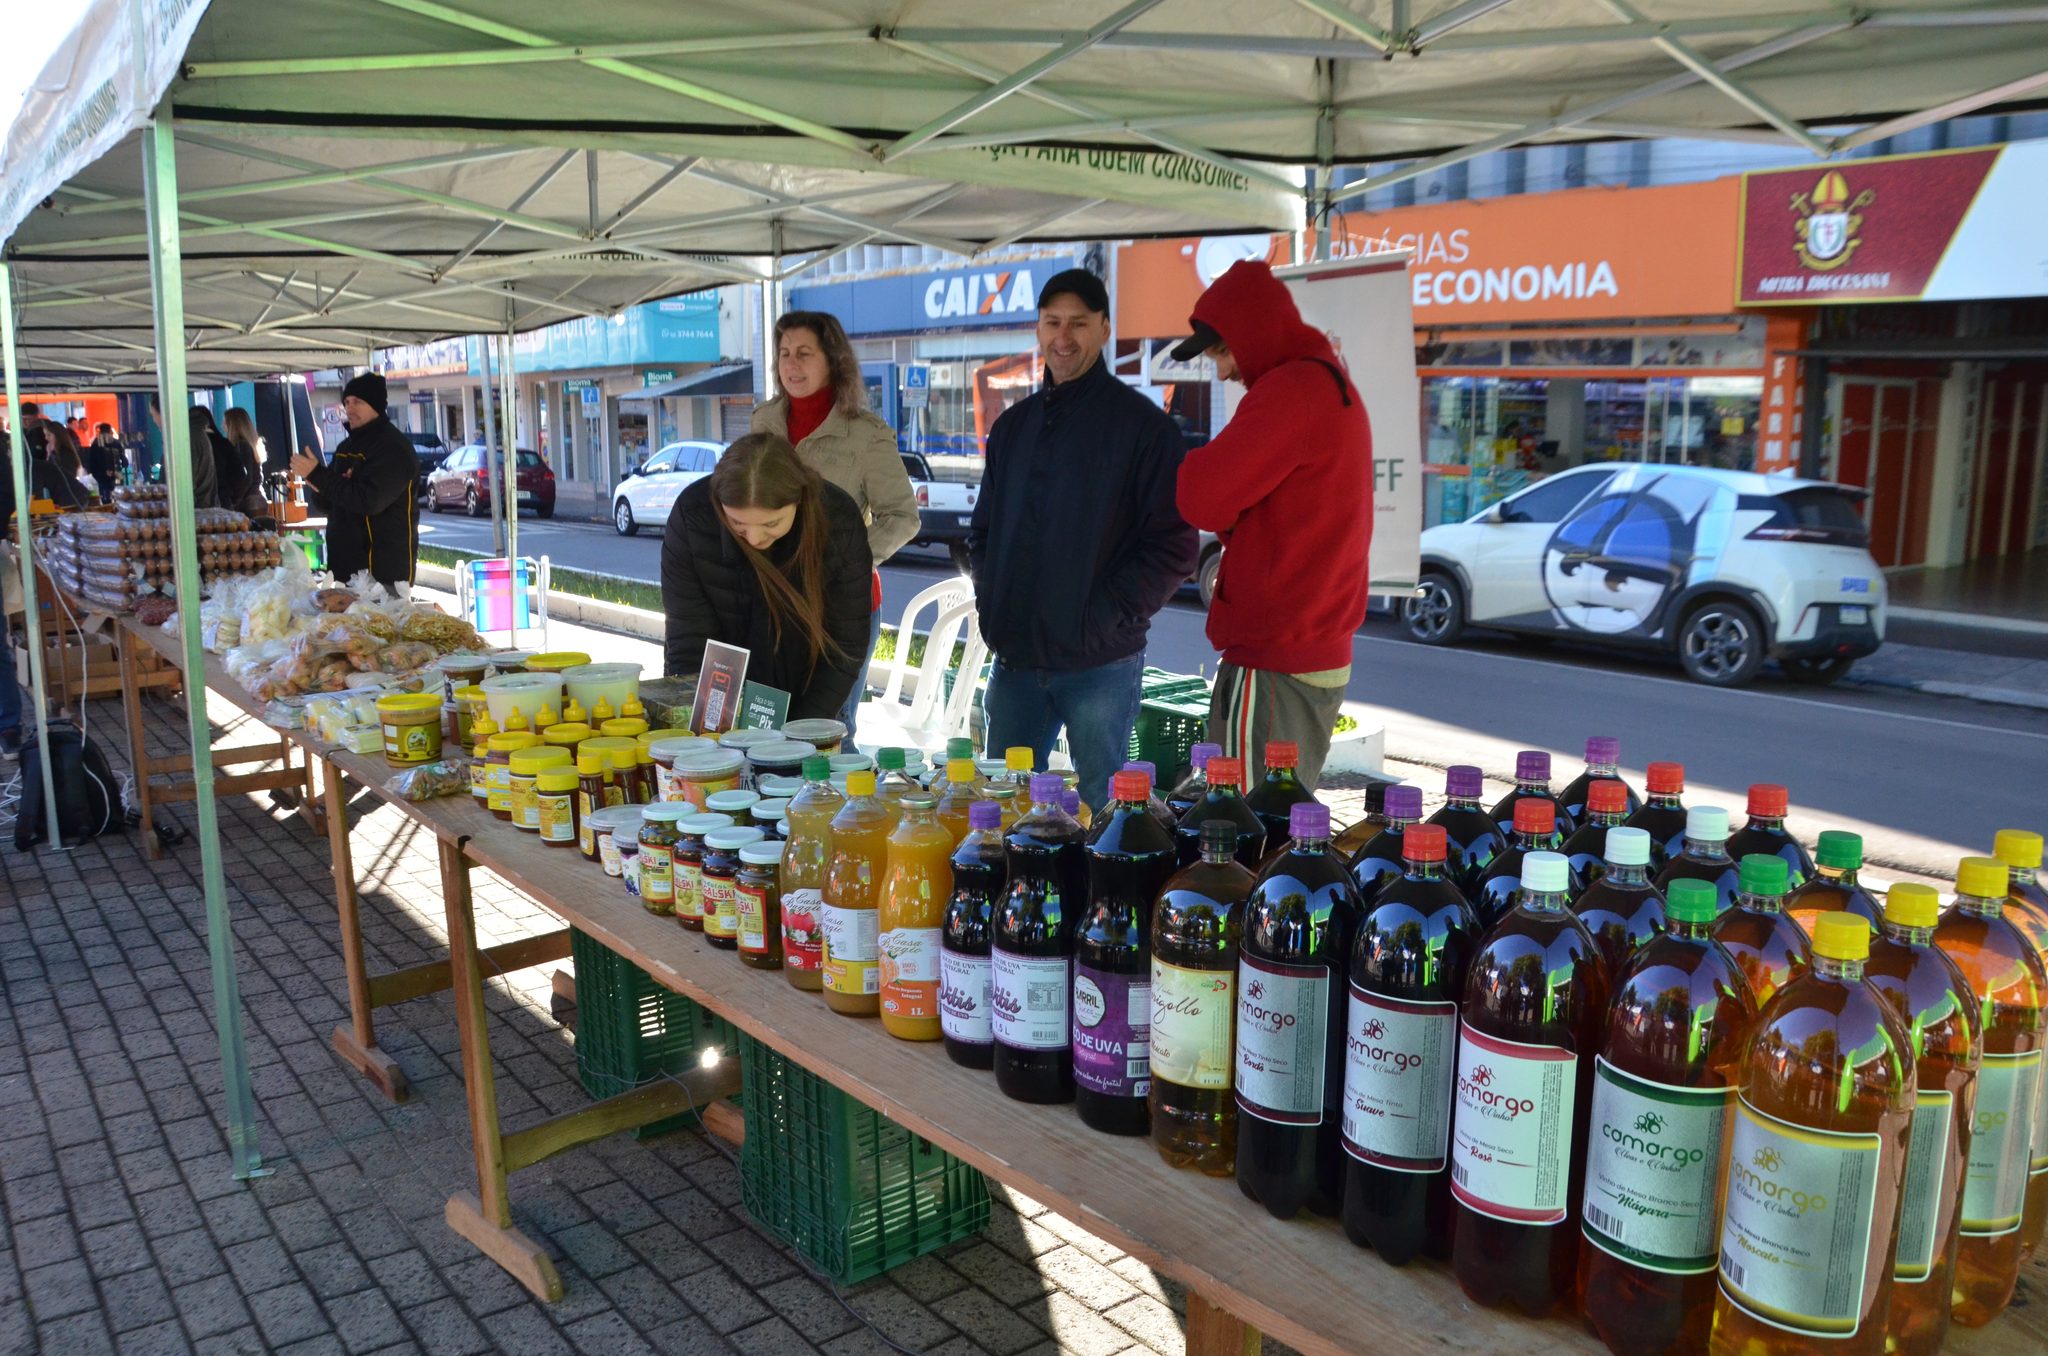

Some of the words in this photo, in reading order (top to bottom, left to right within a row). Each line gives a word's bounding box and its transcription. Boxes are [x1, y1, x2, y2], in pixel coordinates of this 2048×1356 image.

[1088, 148, 1144, 174] QUEM
[924, 269, 1035, 319] CAIXA
[1412, 260, 1618, 306] ECONOMIA
[1764, 356, 1787, 474] FARM
[750, 703, 775, 716] pagamento
[759, 715, 774, 730] Pix
[881, 939, 921, 955] Baggio
[893, 933, 923, 947] Casa
[962, 962, 977, 970] UVA
[940, 968, 977, 1012] Vitis
[911, 1007, 924, 1016] 1L
[1239, 996, 1296, 1030] amargo
[1081, 1034, 1094, 1049] DE
[1095, 1039, 1123, 1055] UVA
[1458, 1073, 1534, 1117] camargo
[1355, 1099, 1385, 1118] Suave
[1479, 1139, 1496, 1151] Mesa
[1497, 1146, 1514, 1155] Seco
[1602, 1123, 1704, 1168] camargo
[1616, 1182, 1626, 1192] de
[1627, 1187, 1647, 1200] Mesa
[1648, 1194, 1679, 1208] Branco
[1680, 1200, 1700, 1209] Seco
[1732, 1156, 1828, 1214] camargo
[1617, 1193, 1670, 1219] Niágara
[1737, 1233, 1780, 1264] Moscato
[1744, 1226, 1761, 1241] Mesa
[1761, 1237, 1789, 1252] Branco
[1790, 1246, 1811, 1258] Seco
